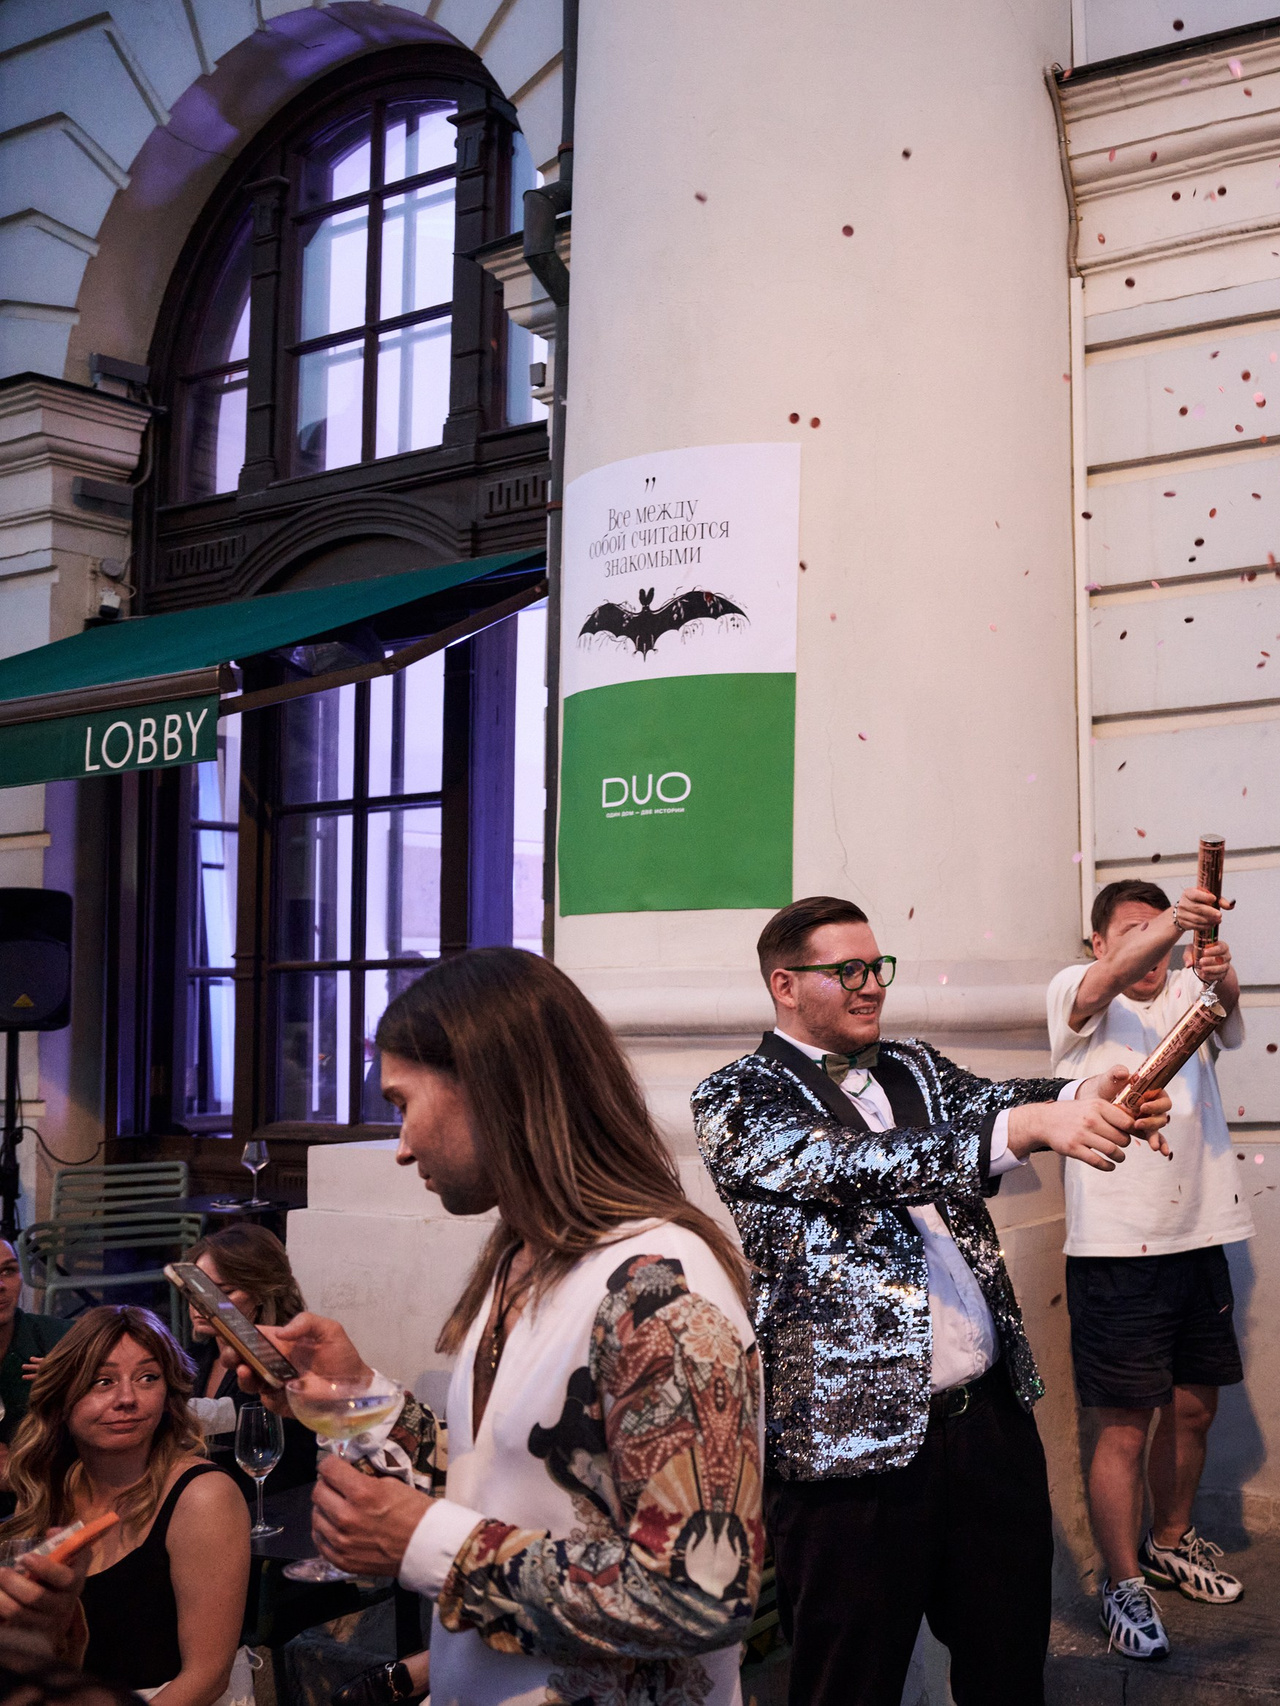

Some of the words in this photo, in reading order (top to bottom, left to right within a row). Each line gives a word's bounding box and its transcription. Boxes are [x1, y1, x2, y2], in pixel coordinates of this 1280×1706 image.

[608, 508, 631, 532] Все
[636, 500, 699, 525] между
[589, 532, 626, 560] собой
[631, 521, 730, 548] считаются
[604, 546, 702, 578] знакомыми
[84, 708, 209, 772] LOBBY
[602, 771, 691, 808] DUO
